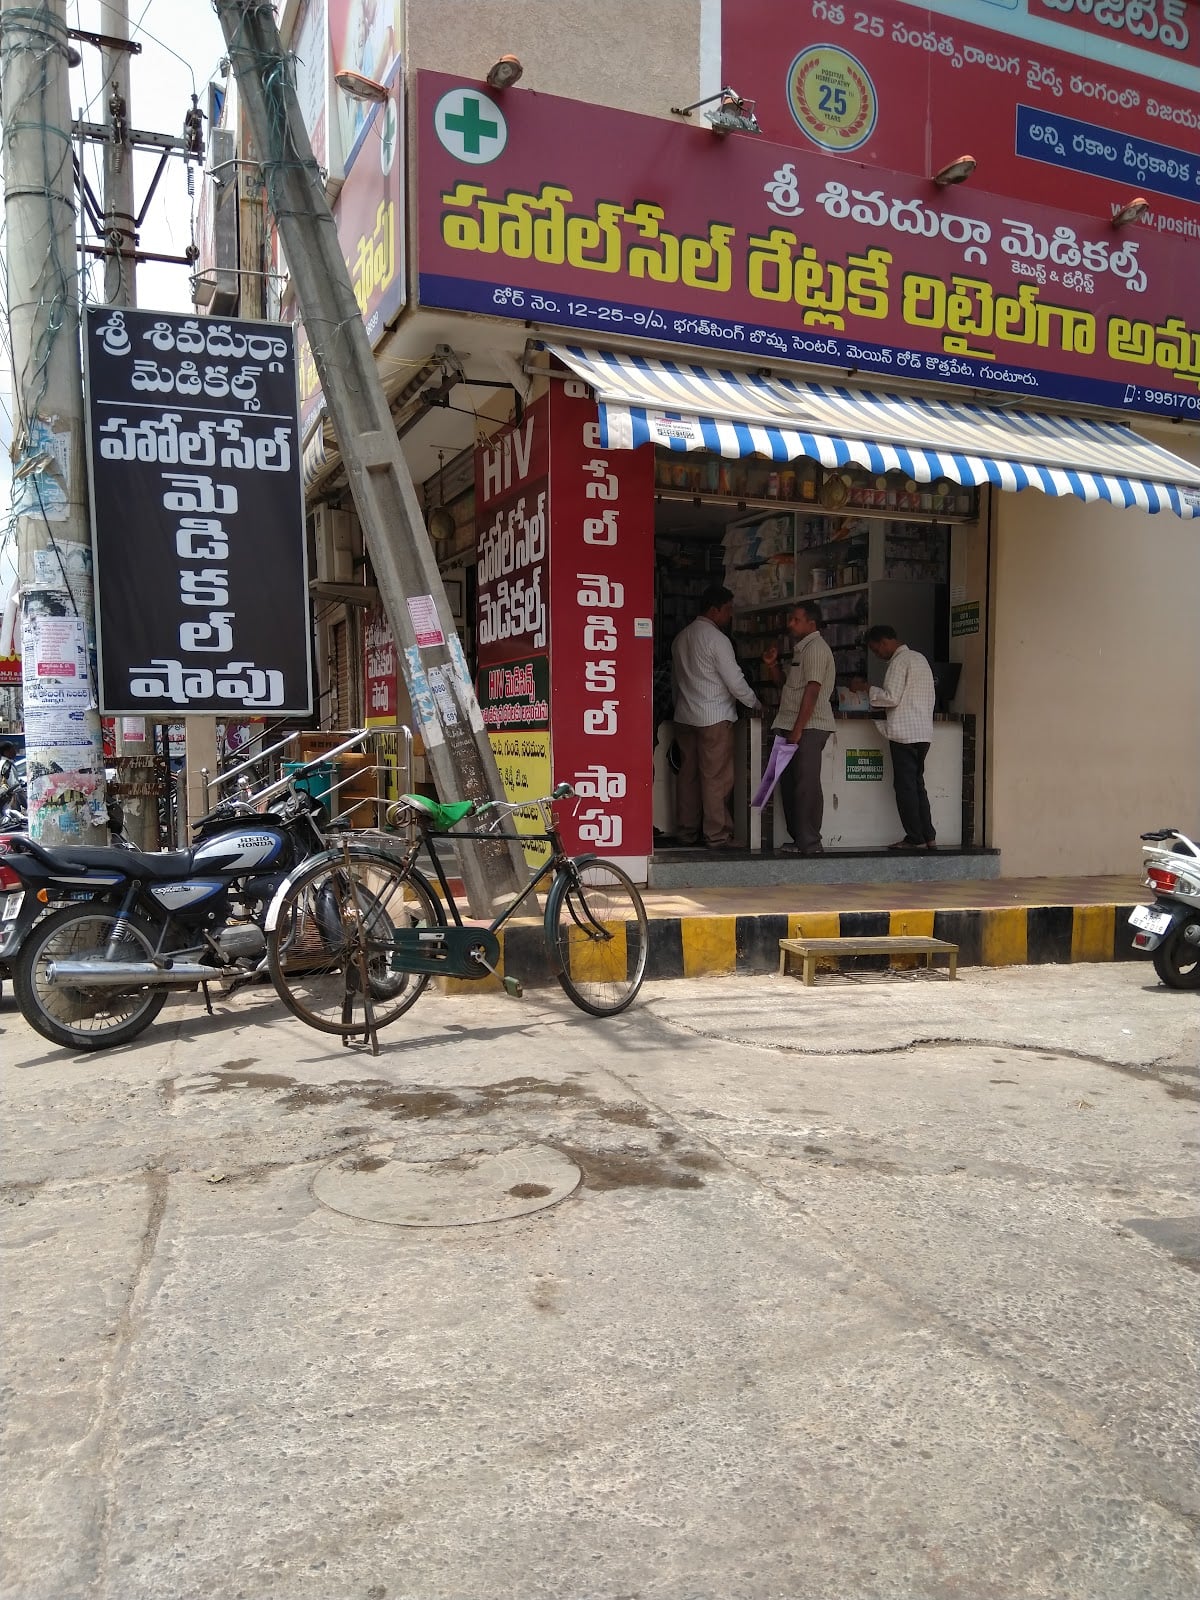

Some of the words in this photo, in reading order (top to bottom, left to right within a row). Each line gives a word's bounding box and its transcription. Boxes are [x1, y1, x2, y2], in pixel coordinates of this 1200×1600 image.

[812, 0, 845, 25] గత
[854, 12, 884, 38] 25
[1026, 60, 1063, 97] వైద్య
[818, 84, 847, 115] 25
[824, 113, 841, 123] YEARS
[1029, 124, 1067, 157] అన్ని
[1072, 134, 1118, 161] రకాల
[763, 163, 805, 217] శ్రీ
[815, 181, 992, 265] శివదుర్గా
[1001, 218, 1148, 293] మెడికల్స్
[748, 229, 893, 331] రేట్లకే
[1049, 270, 1060, 281] &
[95, 310, 132, 356] శ్రీ
[143, 320, 288, 373] శివదుర్గా
[493, 287, 525, 307] డోర్
[750, 329, 787, 352] బొమ్మ
[791, 335, 841, 357] సెంటర్,
[846, 344, 893, 365] మెయిన్
[897, 351, 921, 369] రోడ్
[131, 359, 264, 411] మెడికల్స్
[482, 415, 535, 502] HIV
[479, 565, 546, 649] మెడికల్స్
[128, 659, 285, 707] షాపు
[488, 667, 504, 700] HIV
[237, 841, 274, 849] HONDA
